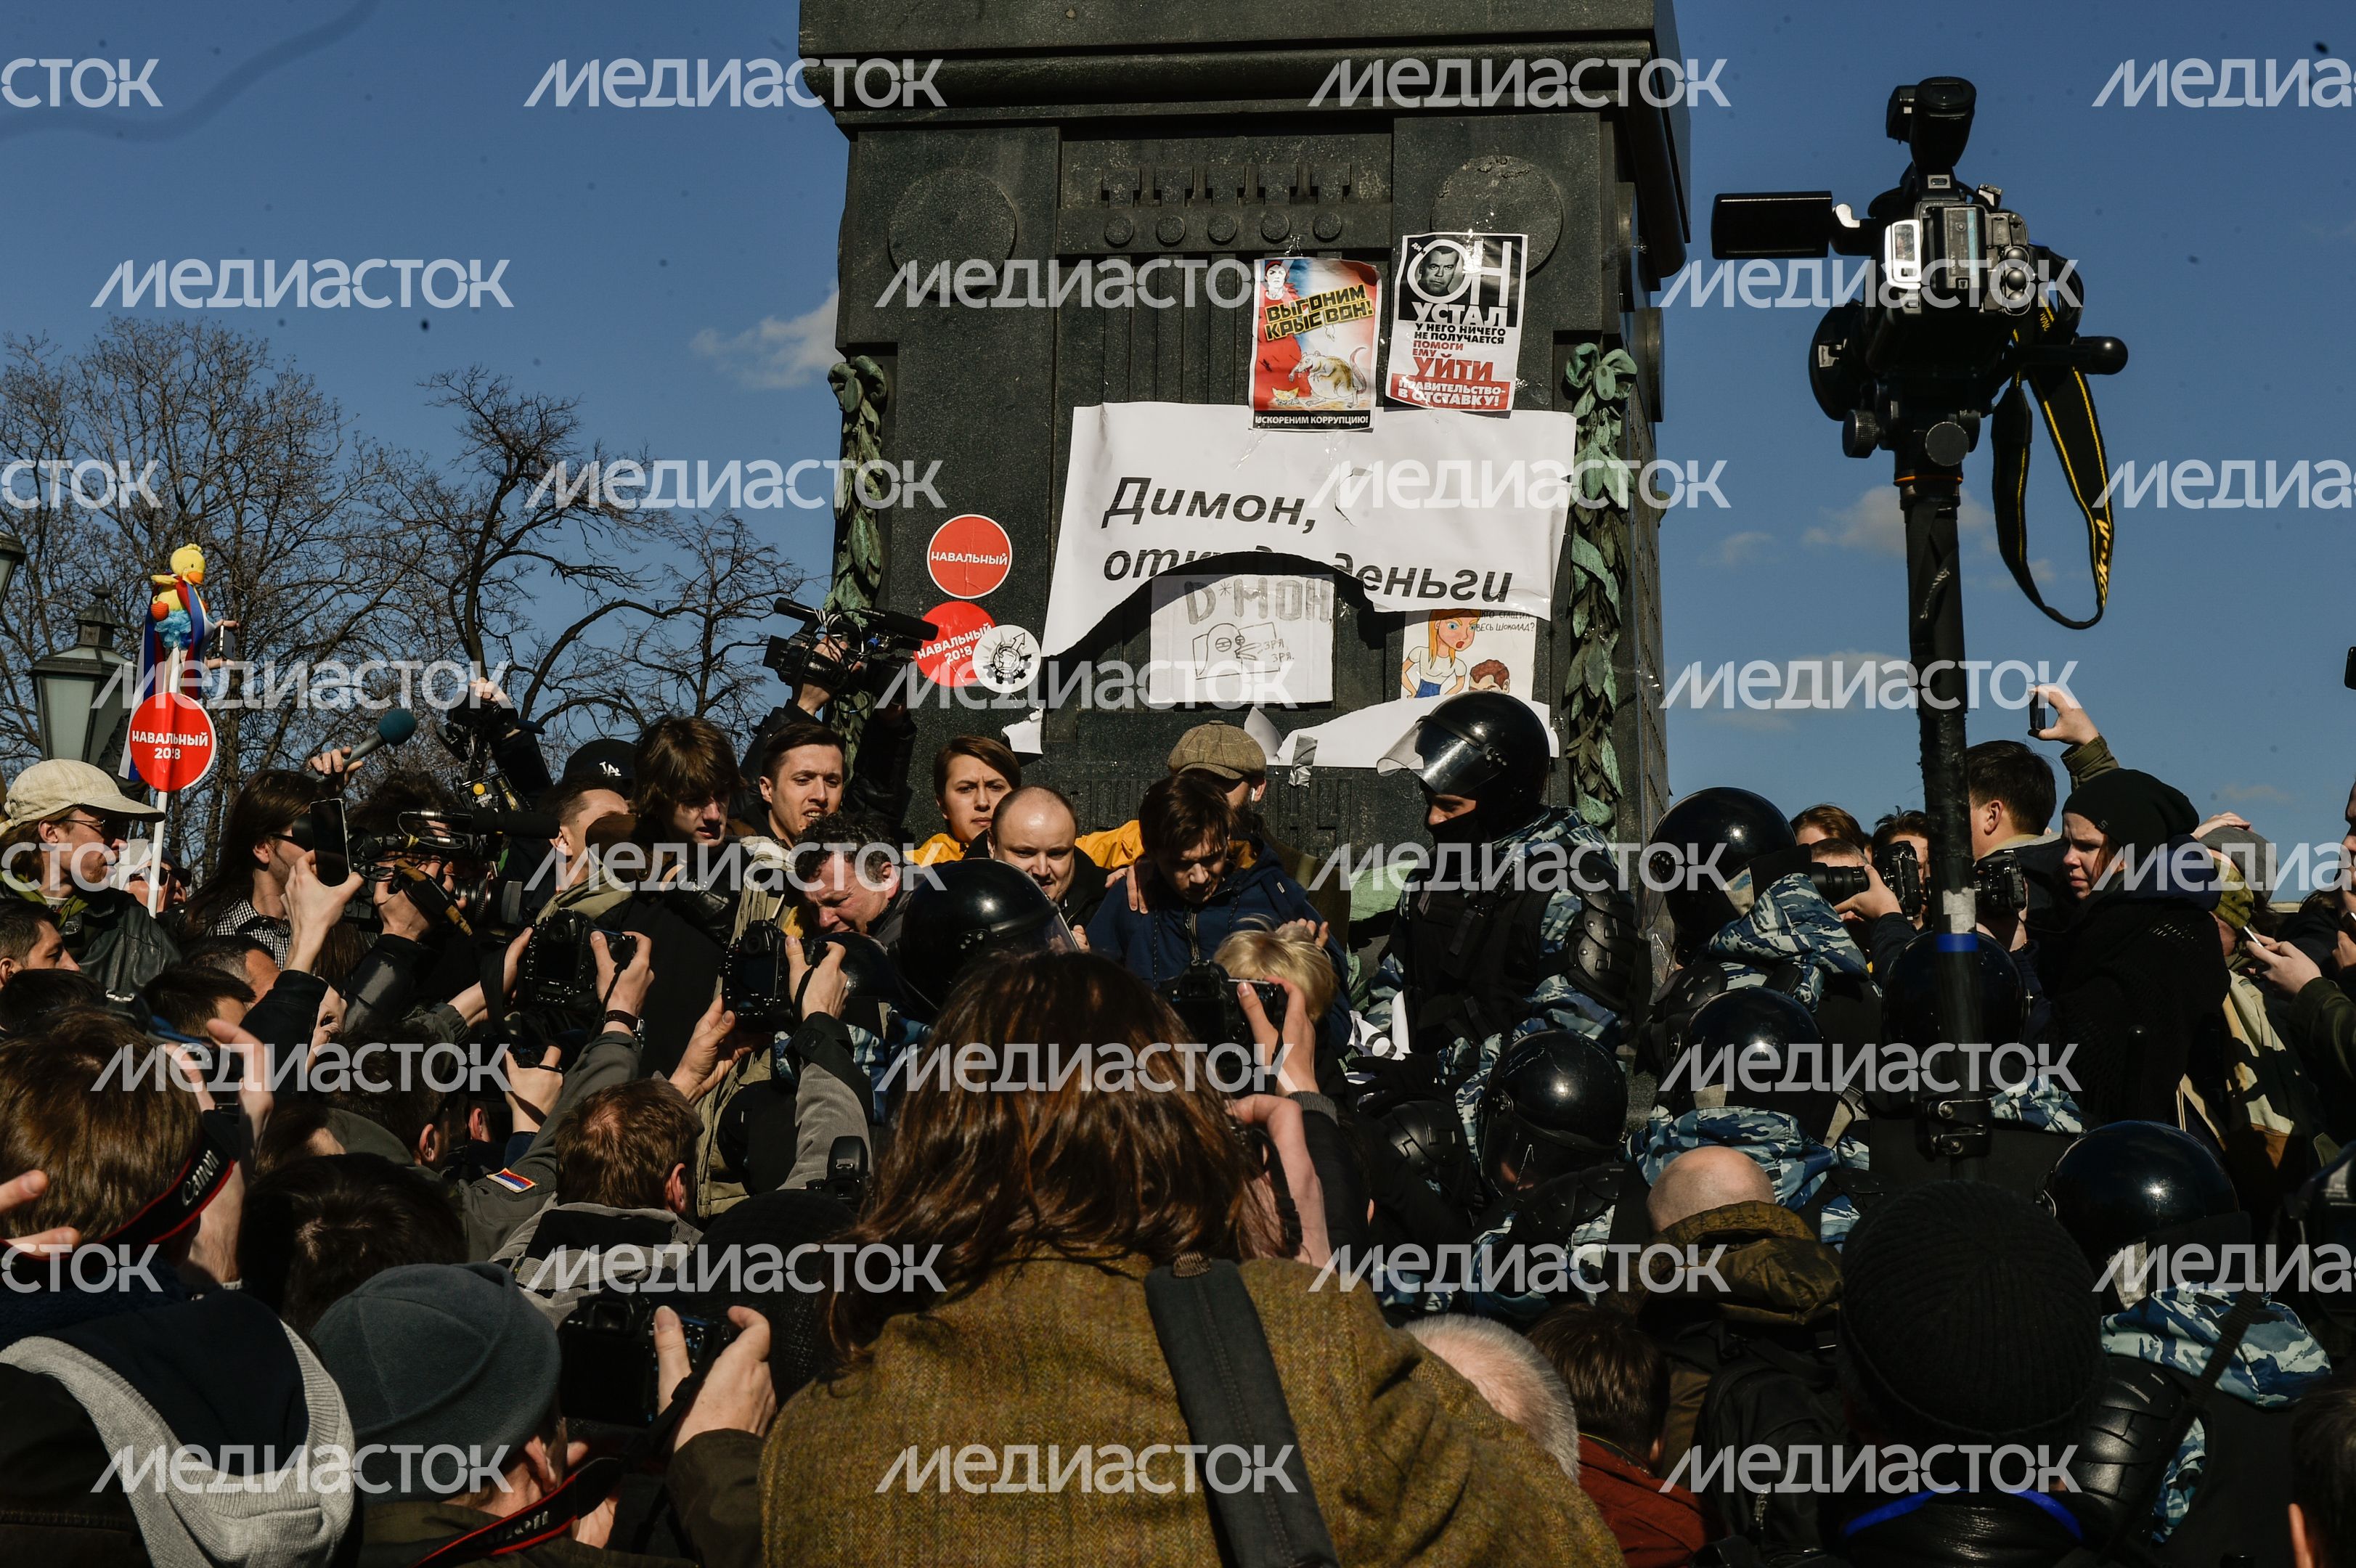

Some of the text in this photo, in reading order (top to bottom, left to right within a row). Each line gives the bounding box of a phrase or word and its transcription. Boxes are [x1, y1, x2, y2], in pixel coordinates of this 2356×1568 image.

[1407, 239, 1512, 306] ОН
[1266, 284, 1366, 322] ВЫГОНИМ
[1265, 301, 1374, 340] КРЫС ВОН!
[1411, 302, 1509, 327] УСТАЛ
[1426, 324, 1456, 333] НЕГО
[1459, 326, 1506, 336] НИЧЕГО
[1430, 332, 1504, 345] ПОЛУЧАЕТСЯ
[1412, 348, 1437, 357] ЕМУ
[1413, 340, 1464, 351] ПОМОГИ
[1413, 353, 1493, 382] УЙТИ
[1398, 388, 1499, 407] В ОТСТАВКУ!
[1255, 415, 1369, 425] ИСКОРЕНИМ КОРРУПЦИЮ!
[1101, 476, 1316, 534] Димон,
[931, 551, 1008, 566] НАВАЛЬНЫЙ
[917, 622, 993, 660] НАВАЛЬНЫЙ
[131, 730, 209, 747] НАВАЛЬНЫЙ
[182, 1149, 220, 1206] Canon
